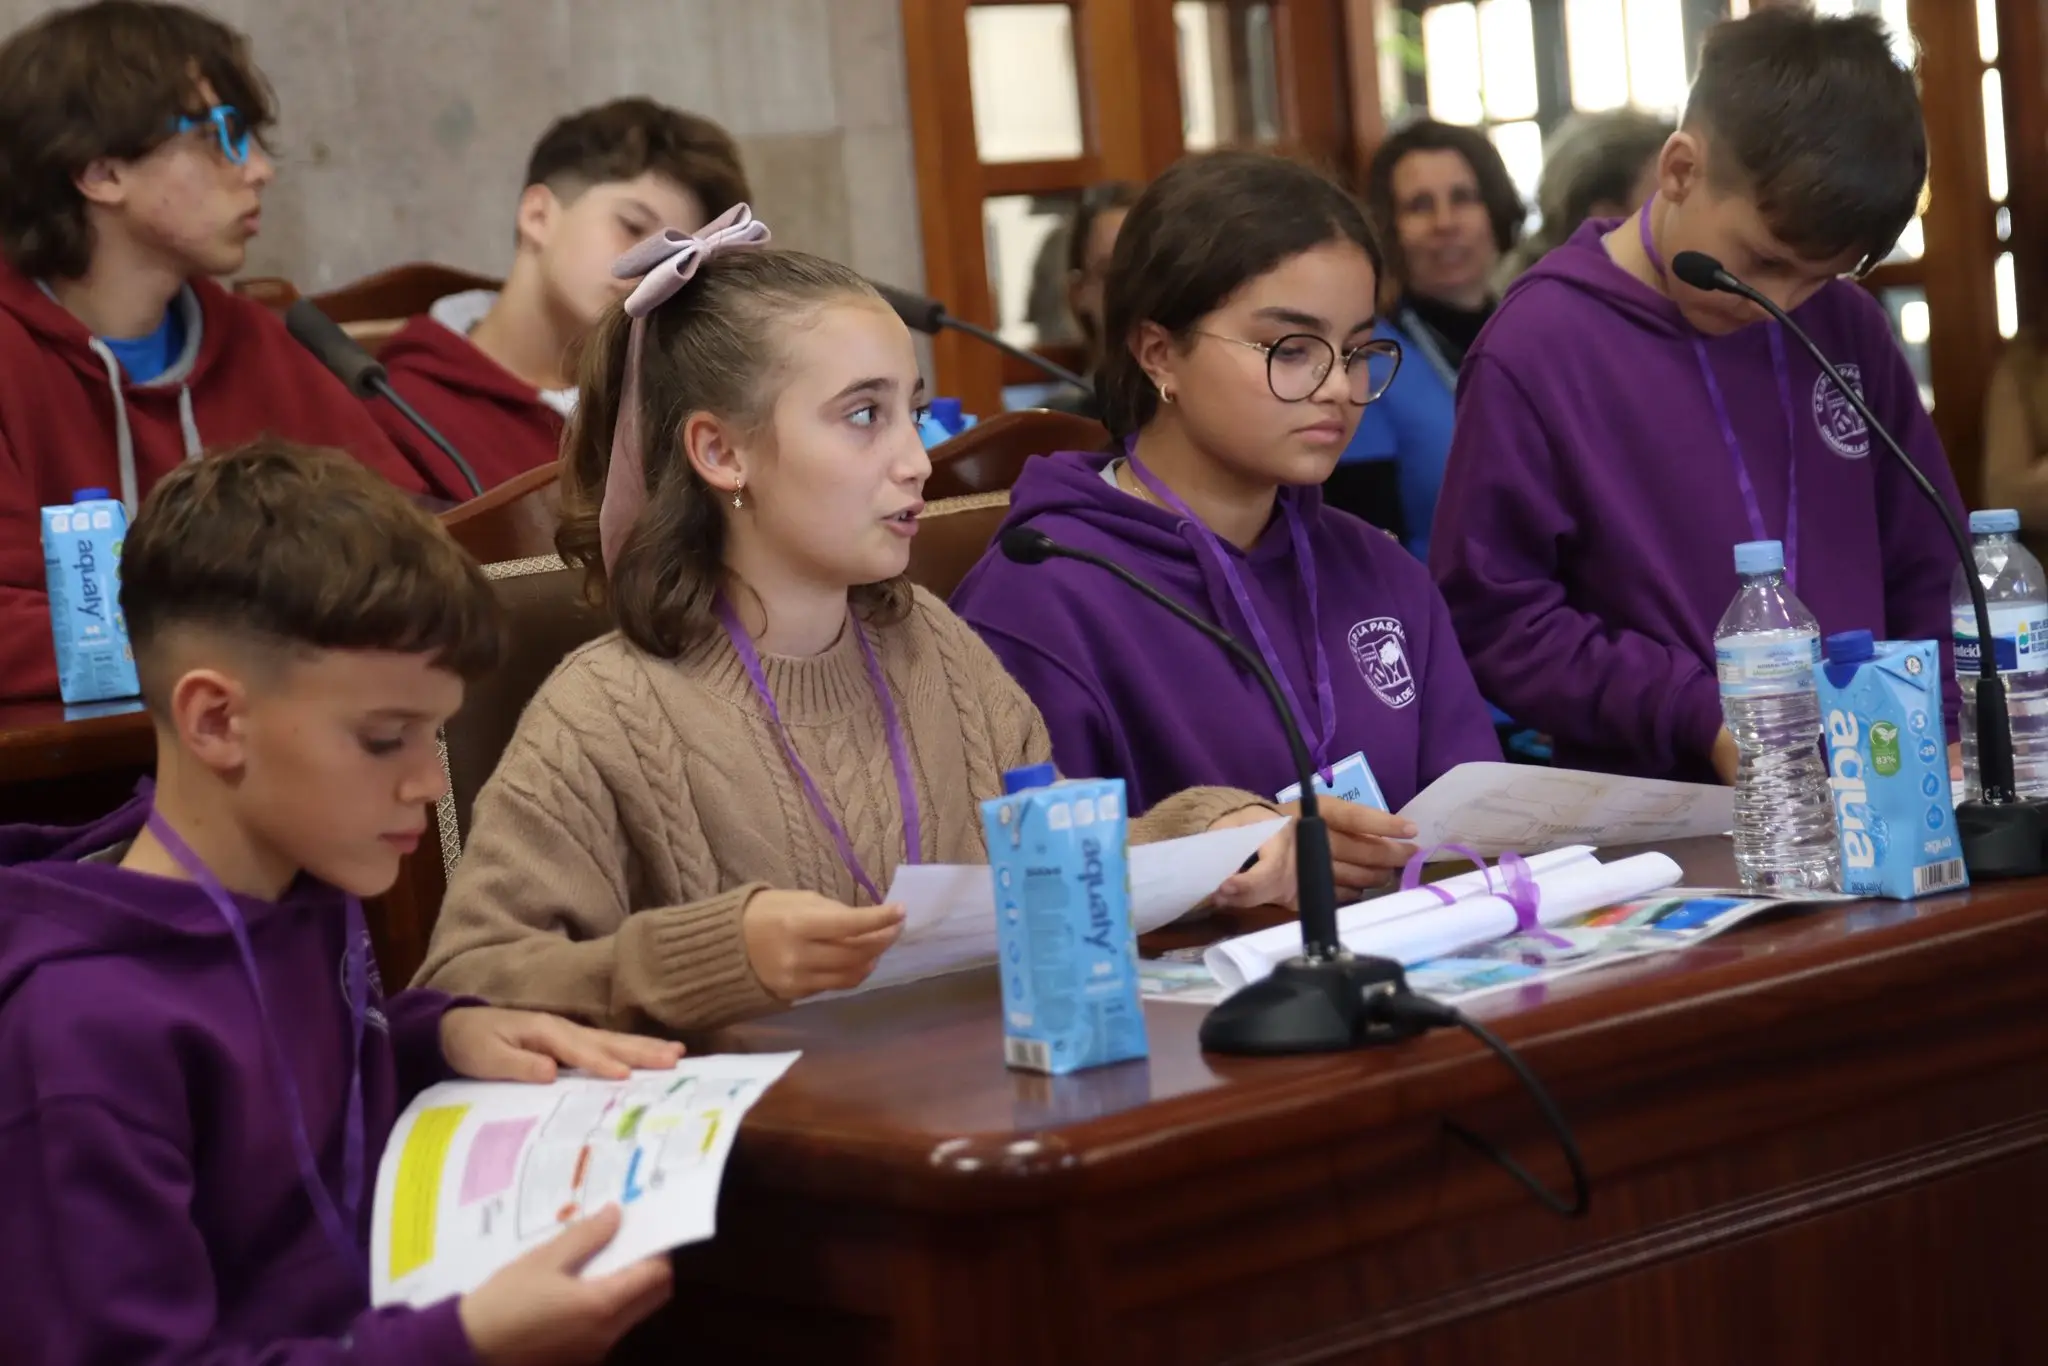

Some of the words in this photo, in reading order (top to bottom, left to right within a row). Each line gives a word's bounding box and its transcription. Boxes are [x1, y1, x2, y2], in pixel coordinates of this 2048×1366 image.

[73, 539, 105, 621] aqualy
[1828, 709, 1875, 868] aqua
[1077, 838, 1117, 954] aqualy
